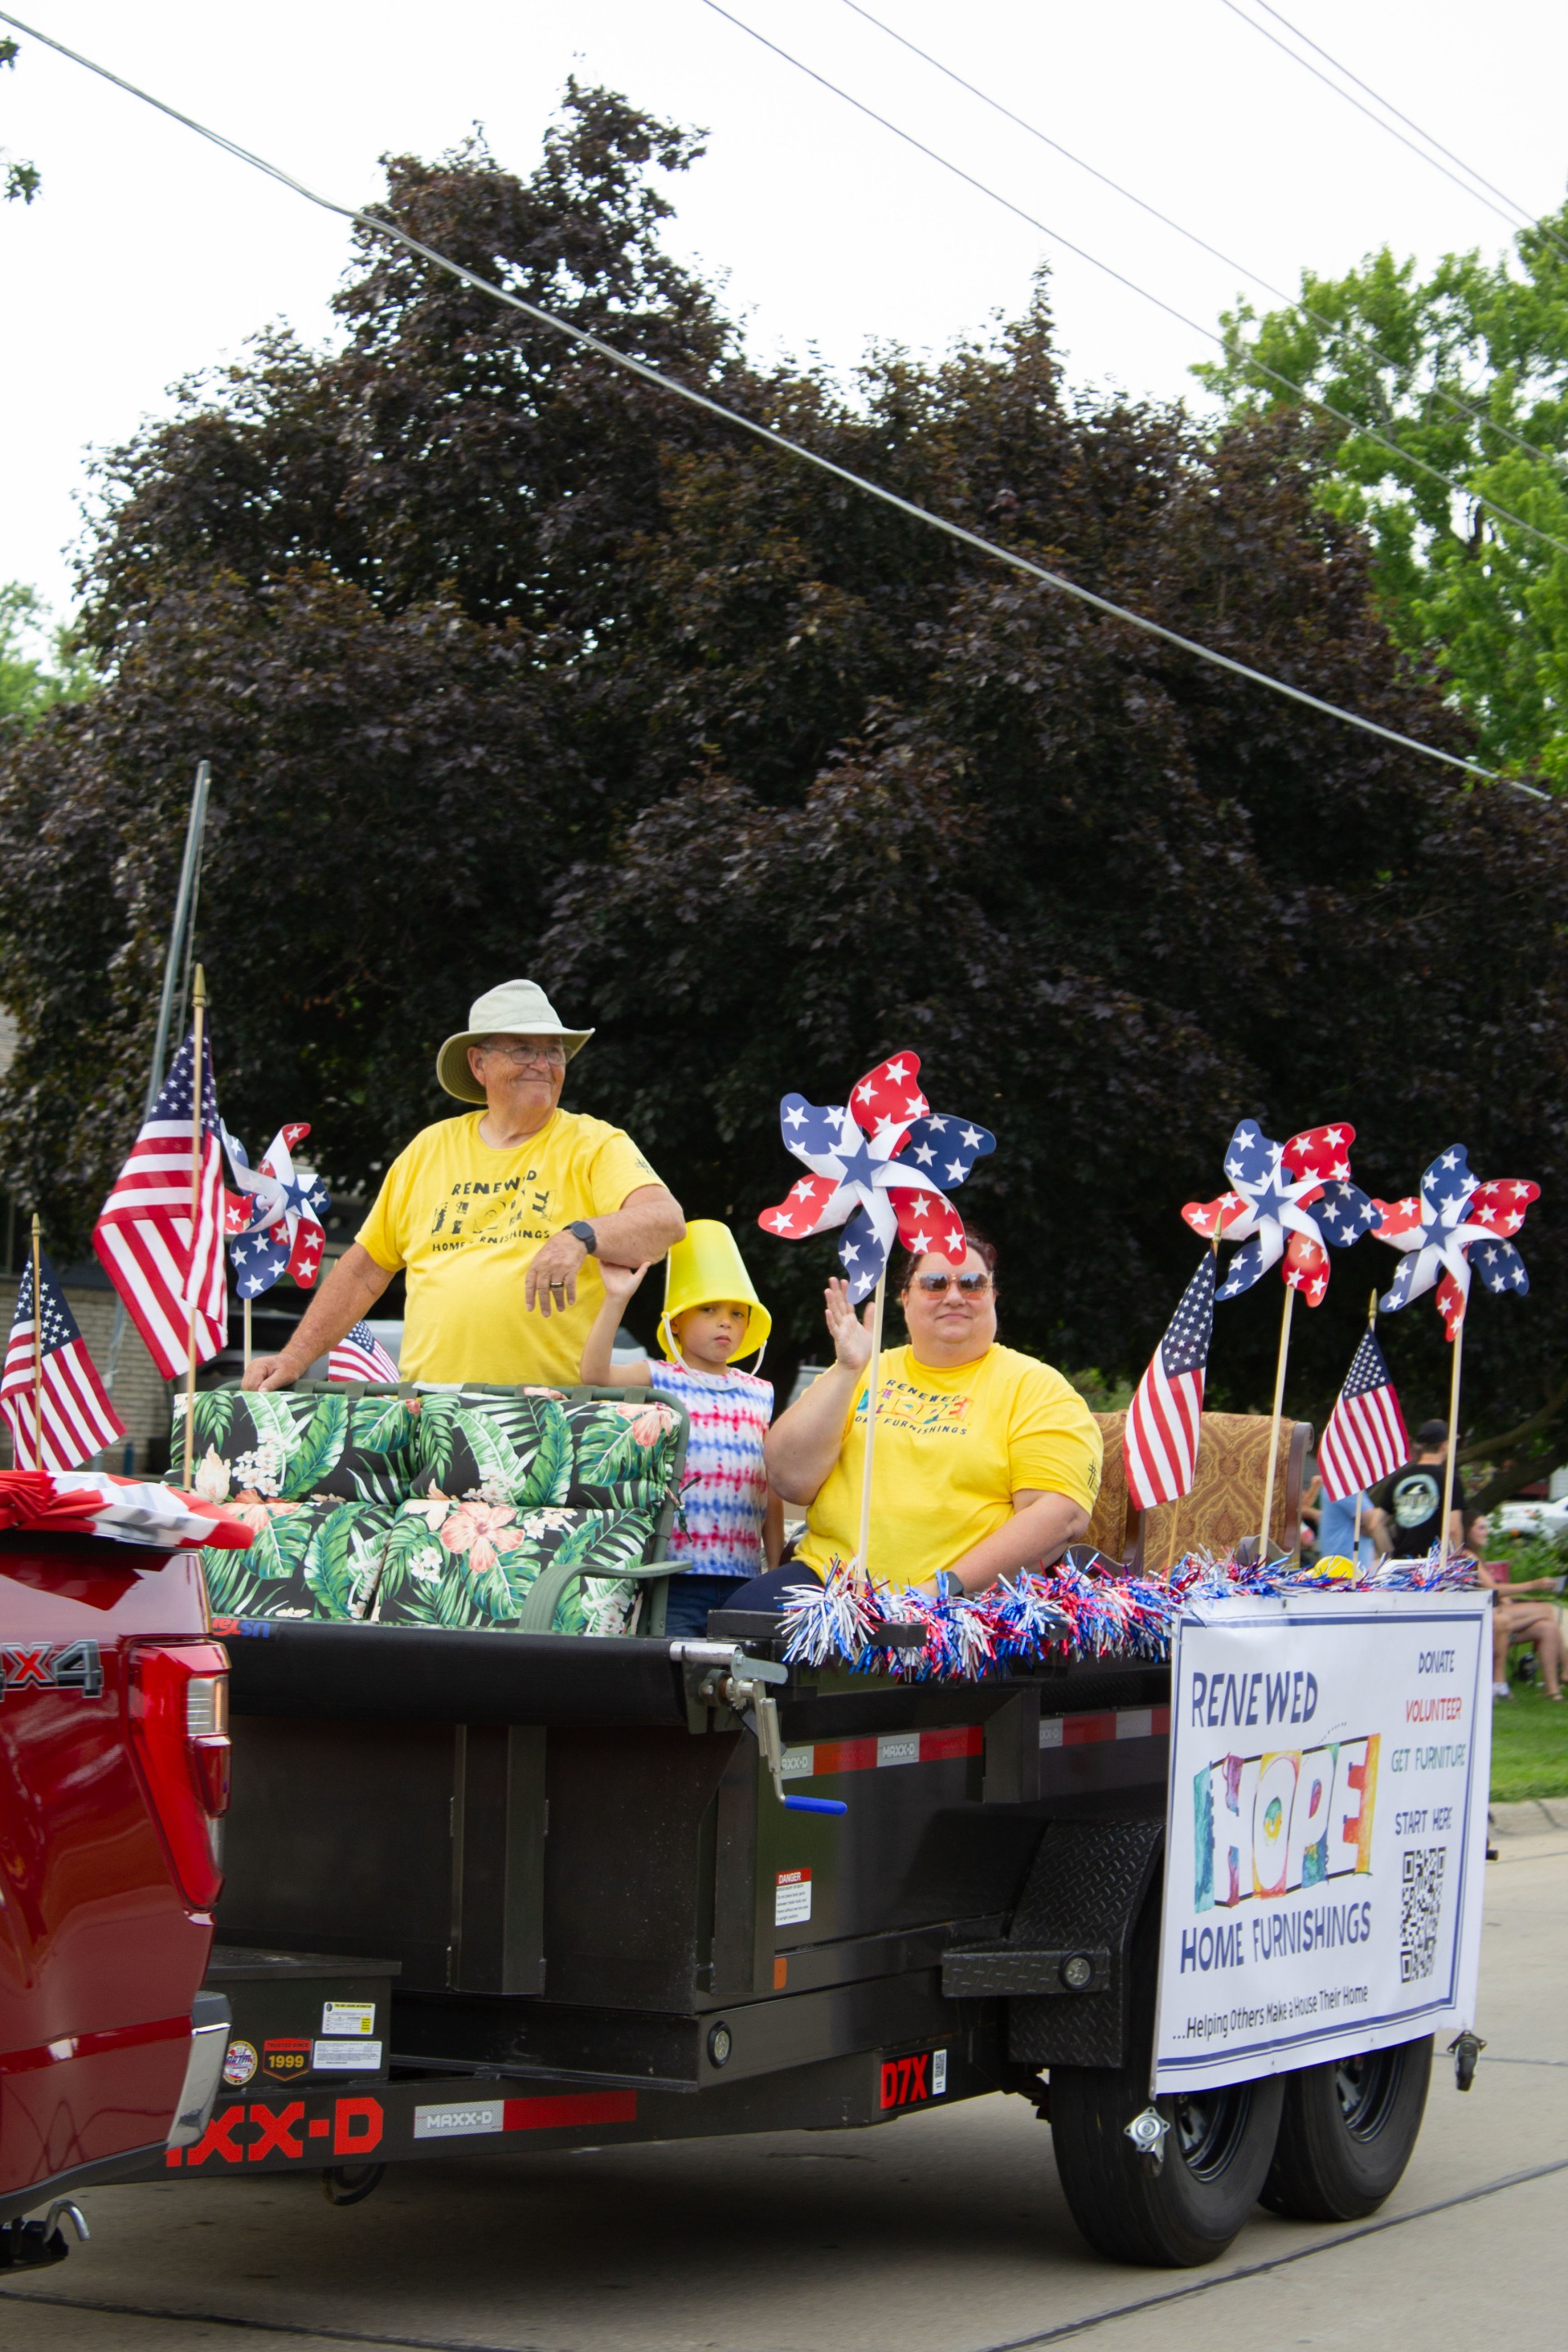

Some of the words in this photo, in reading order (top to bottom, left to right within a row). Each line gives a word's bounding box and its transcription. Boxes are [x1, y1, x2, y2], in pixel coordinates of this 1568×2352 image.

[452, 1169, 537, 1196] RENEWD
[470, 1230, 550, 1245] RNISHINGS
[886, 1379, 960, 1403] RENEWED
[884, 1418, 968, 1435] FURNISHINGS
[1418, 1650, 1455, 1674] DONATE
[1192, 1671, 1319, 1728] RENEWED
[1405, 1696, 1463, 1723] VOLUNTEER
[782, 1755, 808, 1771] AXX-D
[882, 1742, 915, 1758] MAXX-D
[1391, 1748, 1411, 1772] GET
[1414, 1744, 1467, 1771] FURNITURE
[1193, 1732, 1381, 1914] HOPE
[1395, 1809, 1428, 1836] START
[1432, 1806, 1454, 1832] HERE
[778, 1871, 802, 1884] DANGER
[1180, 1921, 1245, 1975] HOME
[1252, 1900, 1372, 1963] FURNISHINGS
[1230, 2007, 1264, 2031] Others
[1266, 2000, 1288, 2025] Make
[1289, 2001, 1294, 2019] a
[1294, 1994, 1318, 2018] House
[1319, 1988, 1342, 2011] Their
[1342, 1984, 1369, 2007] Home
[269, 2055, 305, 2069] 1999
[880, 2054, 929, 2109] D7X
[166, 2097, 384, 2167] XX-D
[426, 2110, 493, 2129] MAXX-D
